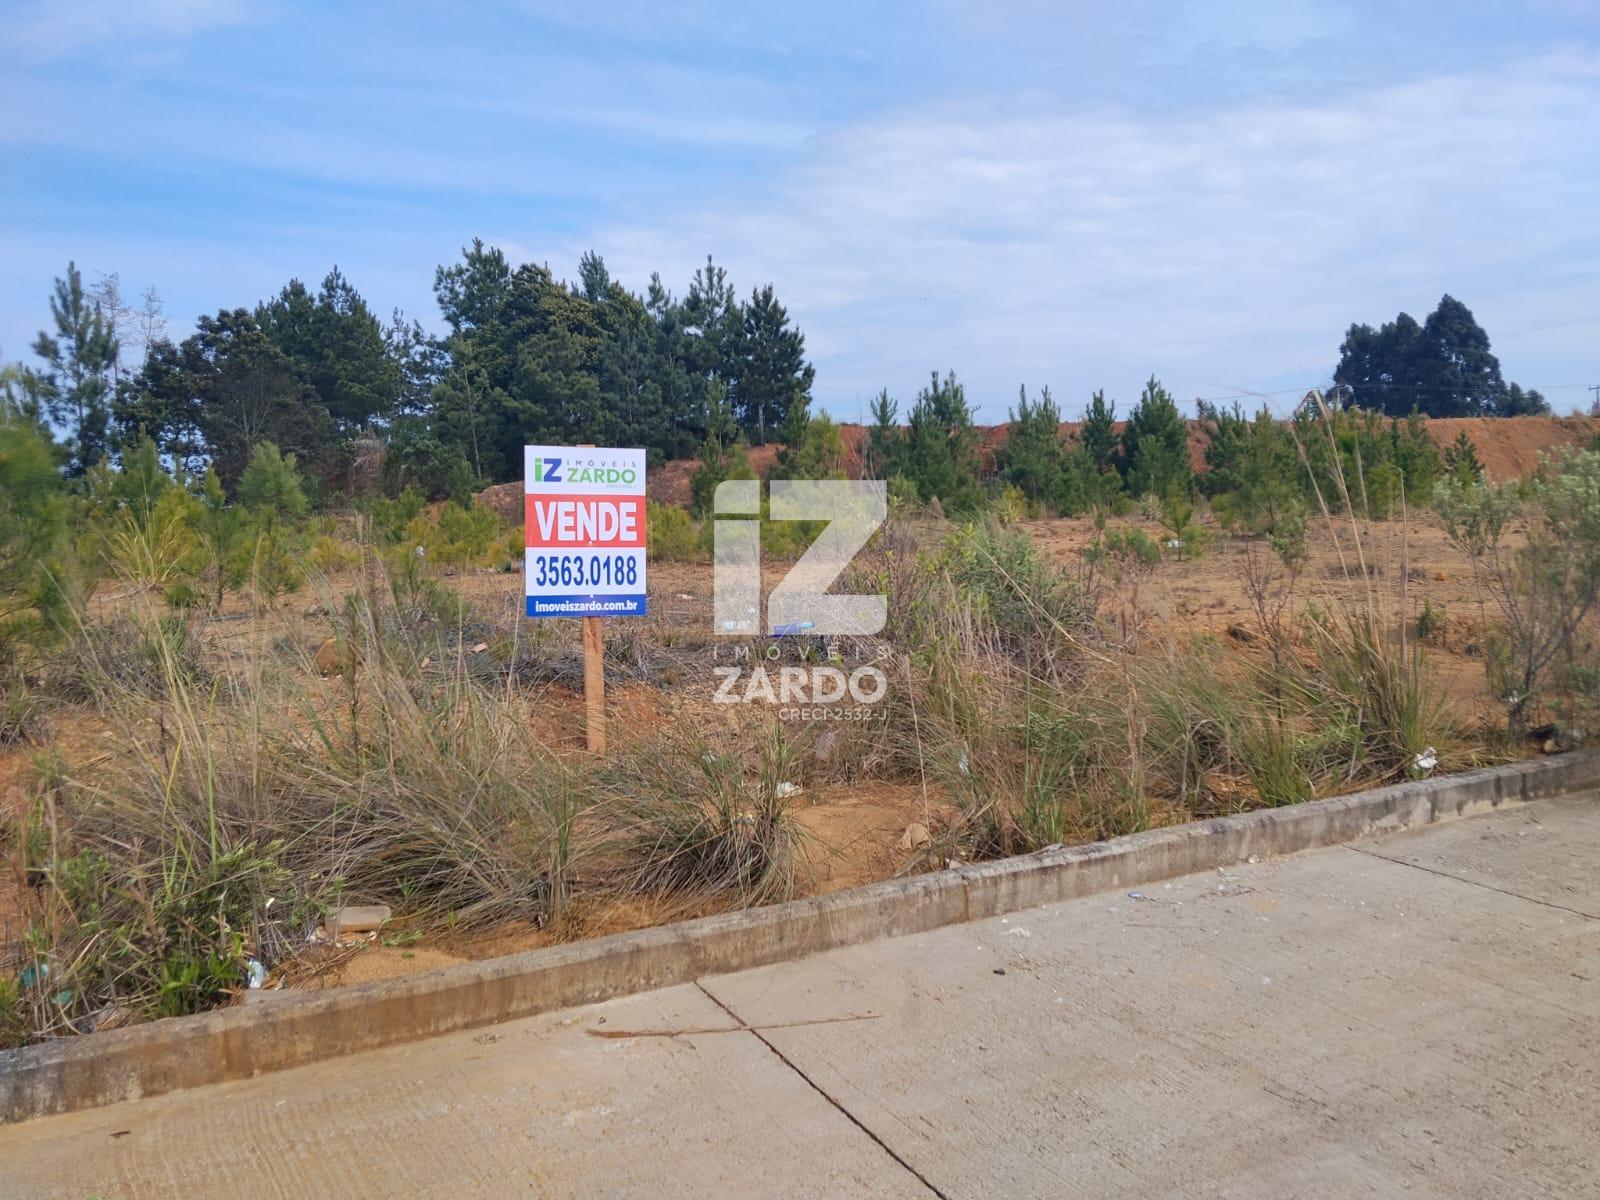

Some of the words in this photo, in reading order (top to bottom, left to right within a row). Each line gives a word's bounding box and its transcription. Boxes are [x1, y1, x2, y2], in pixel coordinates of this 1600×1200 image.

[566, 467, 637, 484] ZARDO
[534, 500, 638, 542] VENDE
[536, 555, 638, 587] 3563.0188
[535, 599, 639, 613] imoveiszardo.com.br
